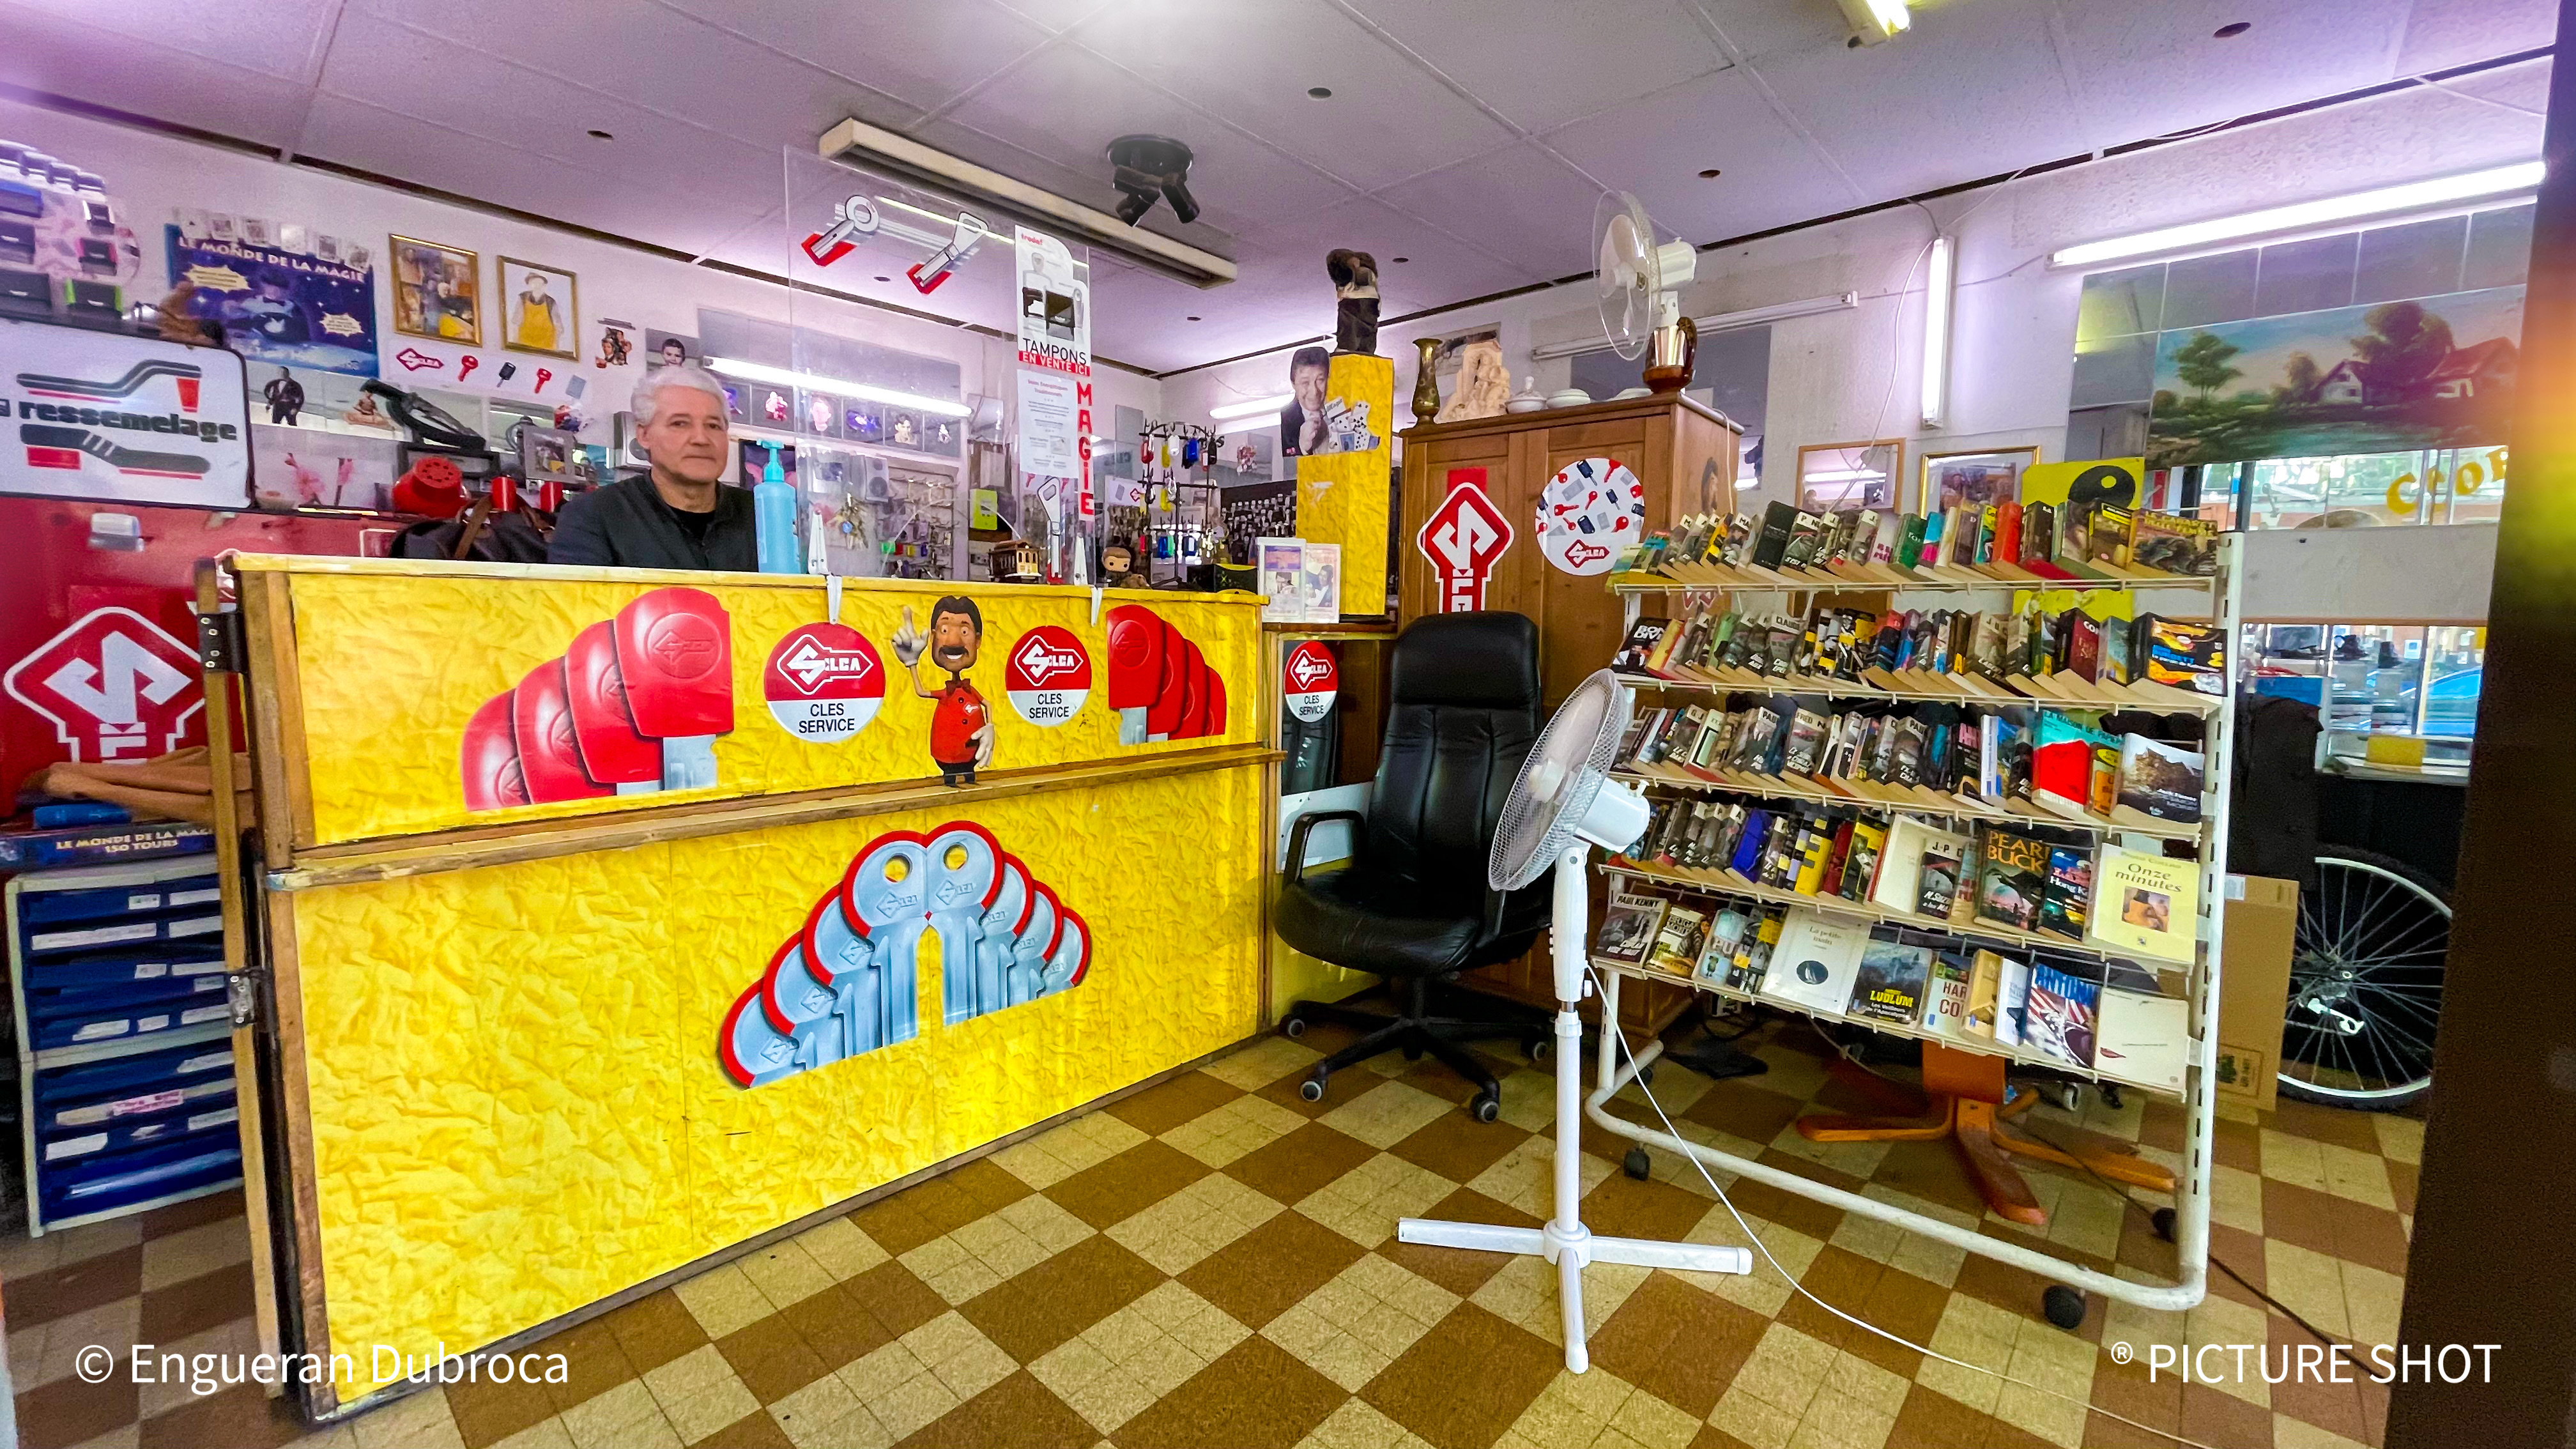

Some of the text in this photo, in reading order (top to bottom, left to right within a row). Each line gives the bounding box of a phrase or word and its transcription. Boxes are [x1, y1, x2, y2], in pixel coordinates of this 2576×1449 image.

[202, 243, 264, 262] MONDE
[268, 254, 288, 266] DE
[293, 258, 312, 272] LA
[316, 265, 365, 284] MAGIE
[1023, 338, 1086, 365] TAMPONS
[1023, 352, 1087, 376] EN VENTE ICI
[19, 401, 237, 442] ressemelage
[787, 644, 861, 685] SILCA
[1022, 643, 1075, 678] SILCA
[1038, 693, 1062, 705] CLES
[1304, 695, 1319, 705] CLES
[810, 703, 844, 716] CLES
[1029, 707, 1070, 719] SERVICE
[1299, 705, 1324, 716] SERVICE
[799, 718, 855, 733] SERVICE
[56, 840, 73, 850] LE
[76, 835, 131, 847] MONDE
[135, 833, 153, 841] DE
[156, 831, 174, 839] LA
[105, 839, 179, 854] 150 TOURS
[1988, 845, 2045, 875] BUCK
[2129, 863, 2171, 880] Onze
[2115, 871, 2182, 892] minutes
[1617, 896, 1659, 908] PAUL KENNY
[1870, 990, 1914, 1008] LUDLUM
